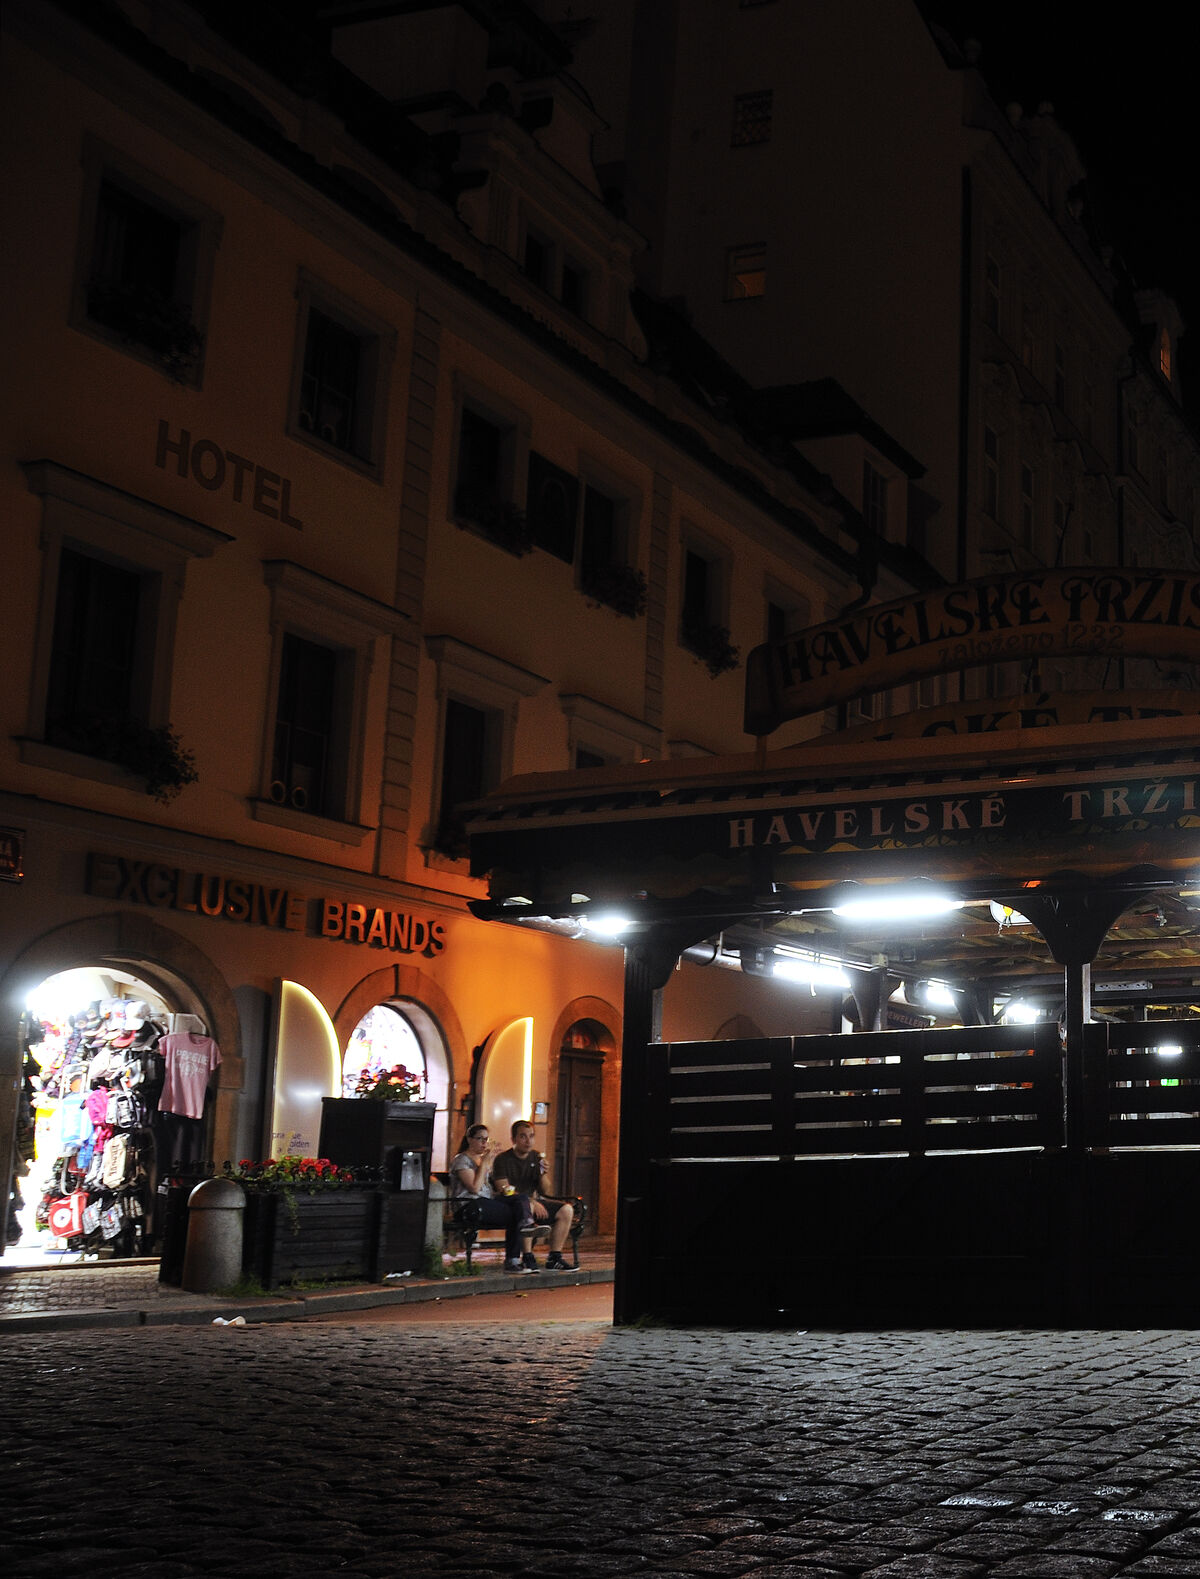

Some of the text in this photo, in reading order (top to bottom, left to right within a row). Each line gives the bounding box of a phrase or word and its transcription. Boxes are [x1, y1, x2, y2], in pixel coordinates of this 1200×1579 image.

[155, 419, 303, 531] HOTEL
[1060, 623, 1125, 651] 1232
[728, 793, 1007, 848] HAVELSKÉ
[85, 851, 448, 957] EXCLUSIVE BRANDS
[888, 1010, 929, 1028] EWELLERY
